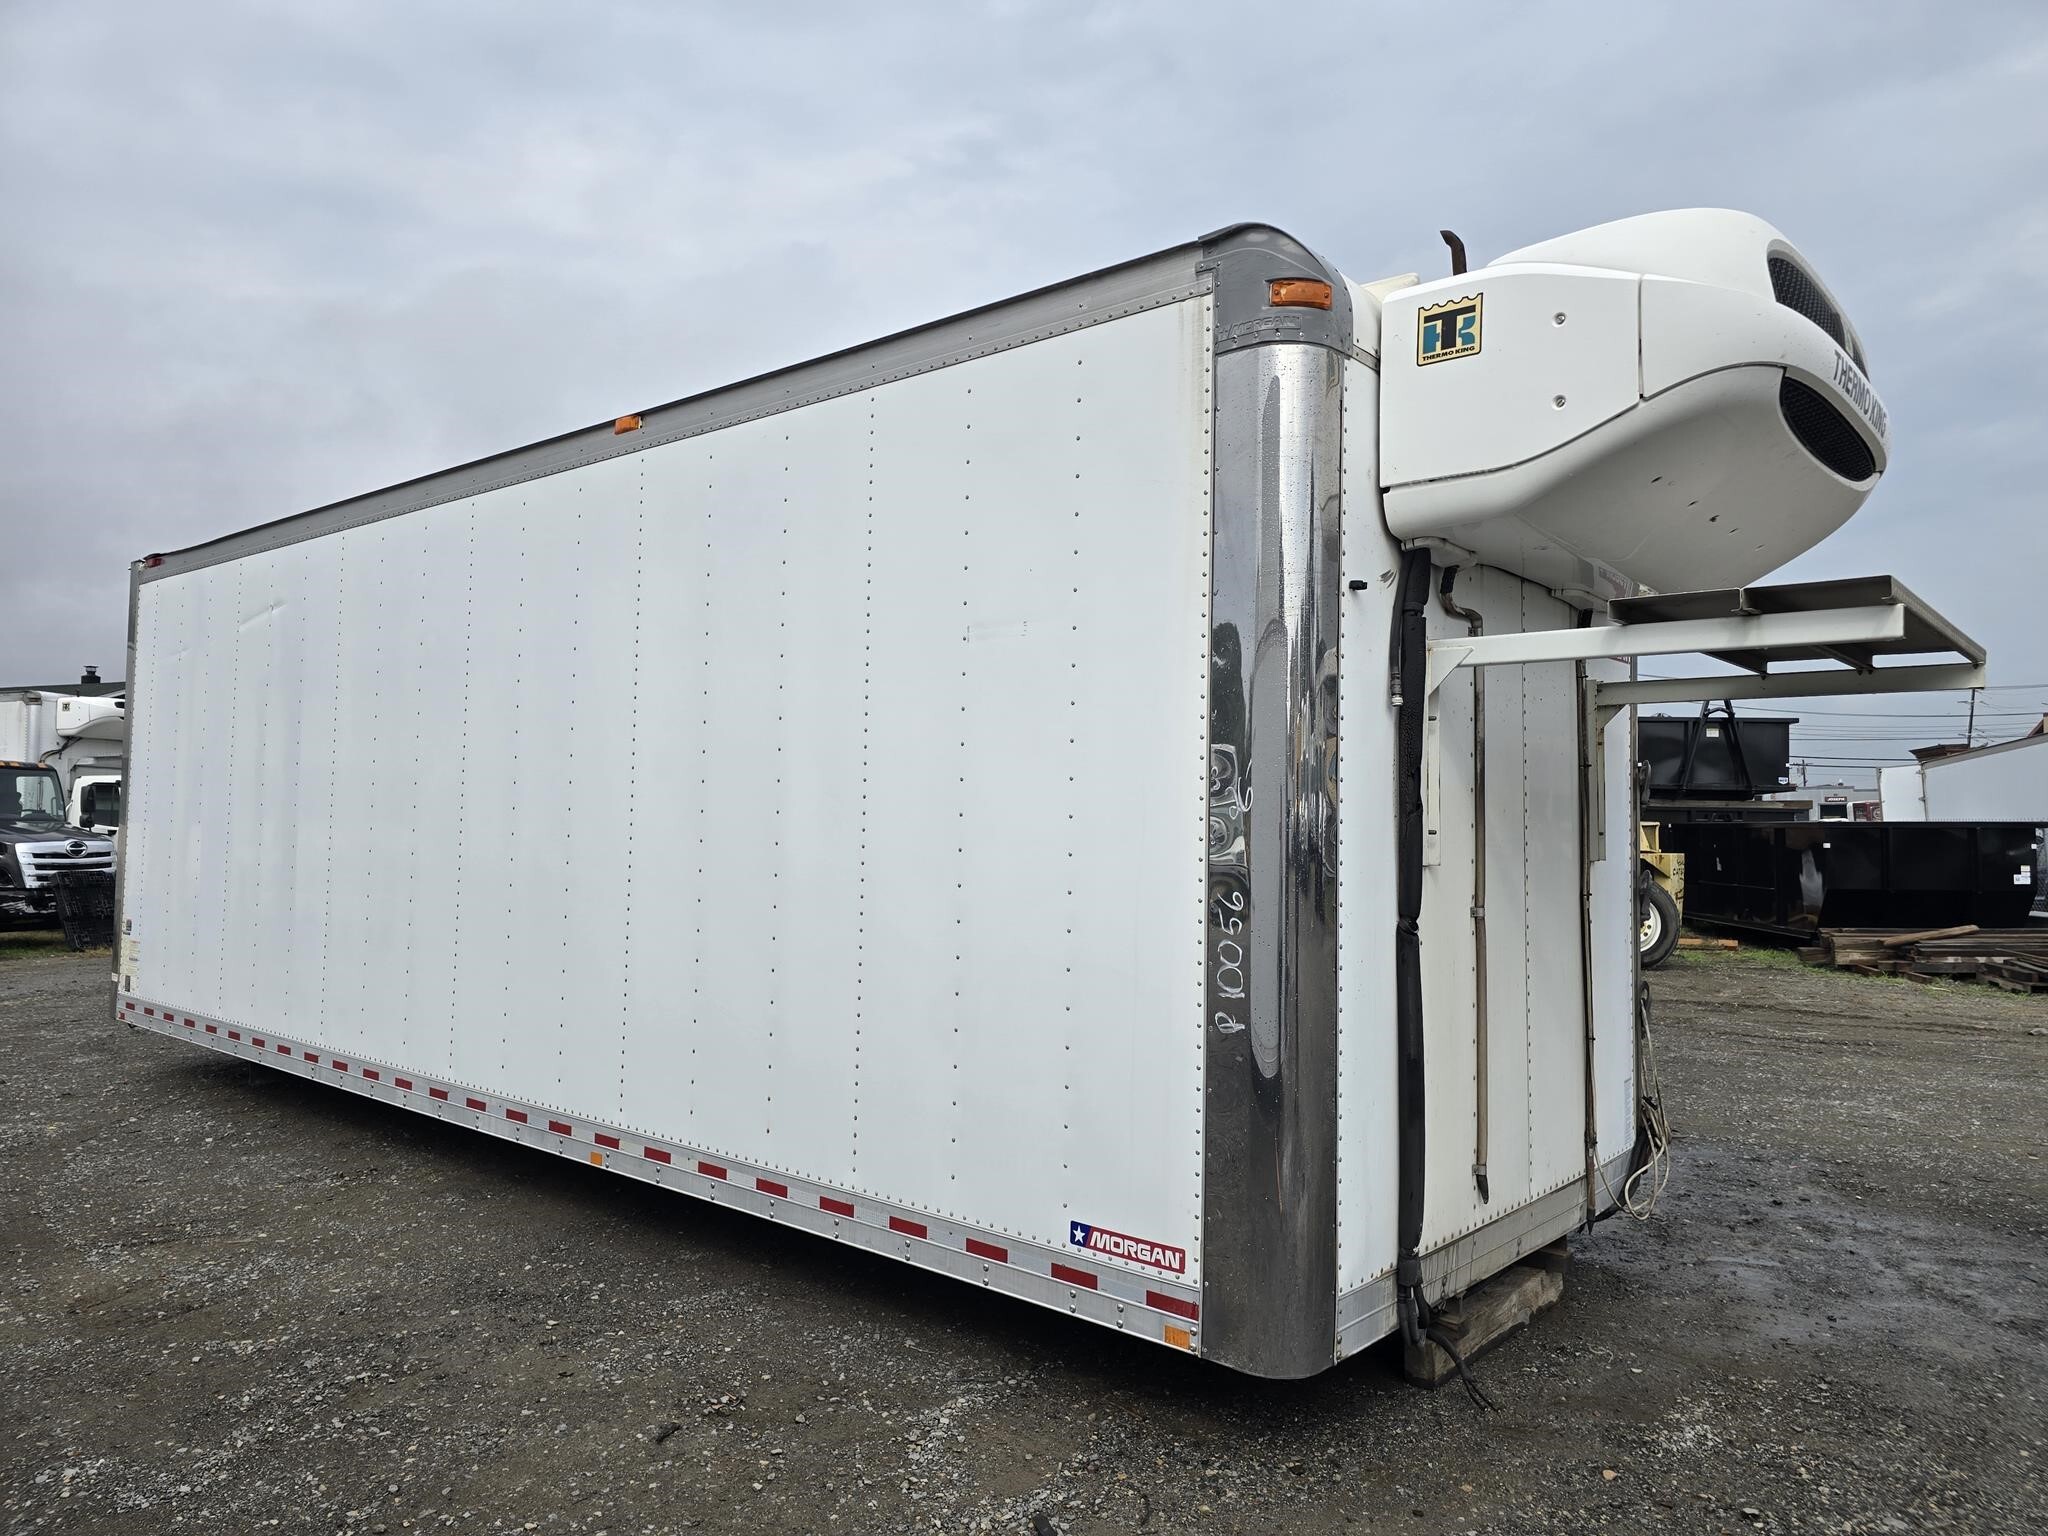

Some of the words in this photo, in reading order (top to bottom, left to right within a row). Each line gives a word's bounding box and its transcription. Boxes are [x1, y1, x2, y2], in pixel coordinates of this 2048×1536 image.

[1422, 350, 1454, 361] THERMO
[1455, 345, 1475, 355] KING
[1834, 349, 1871, 416] THERMO
[1869, 394, 1887, 438] KING
[1090, 1231, 1180, 1269] MORGAN
